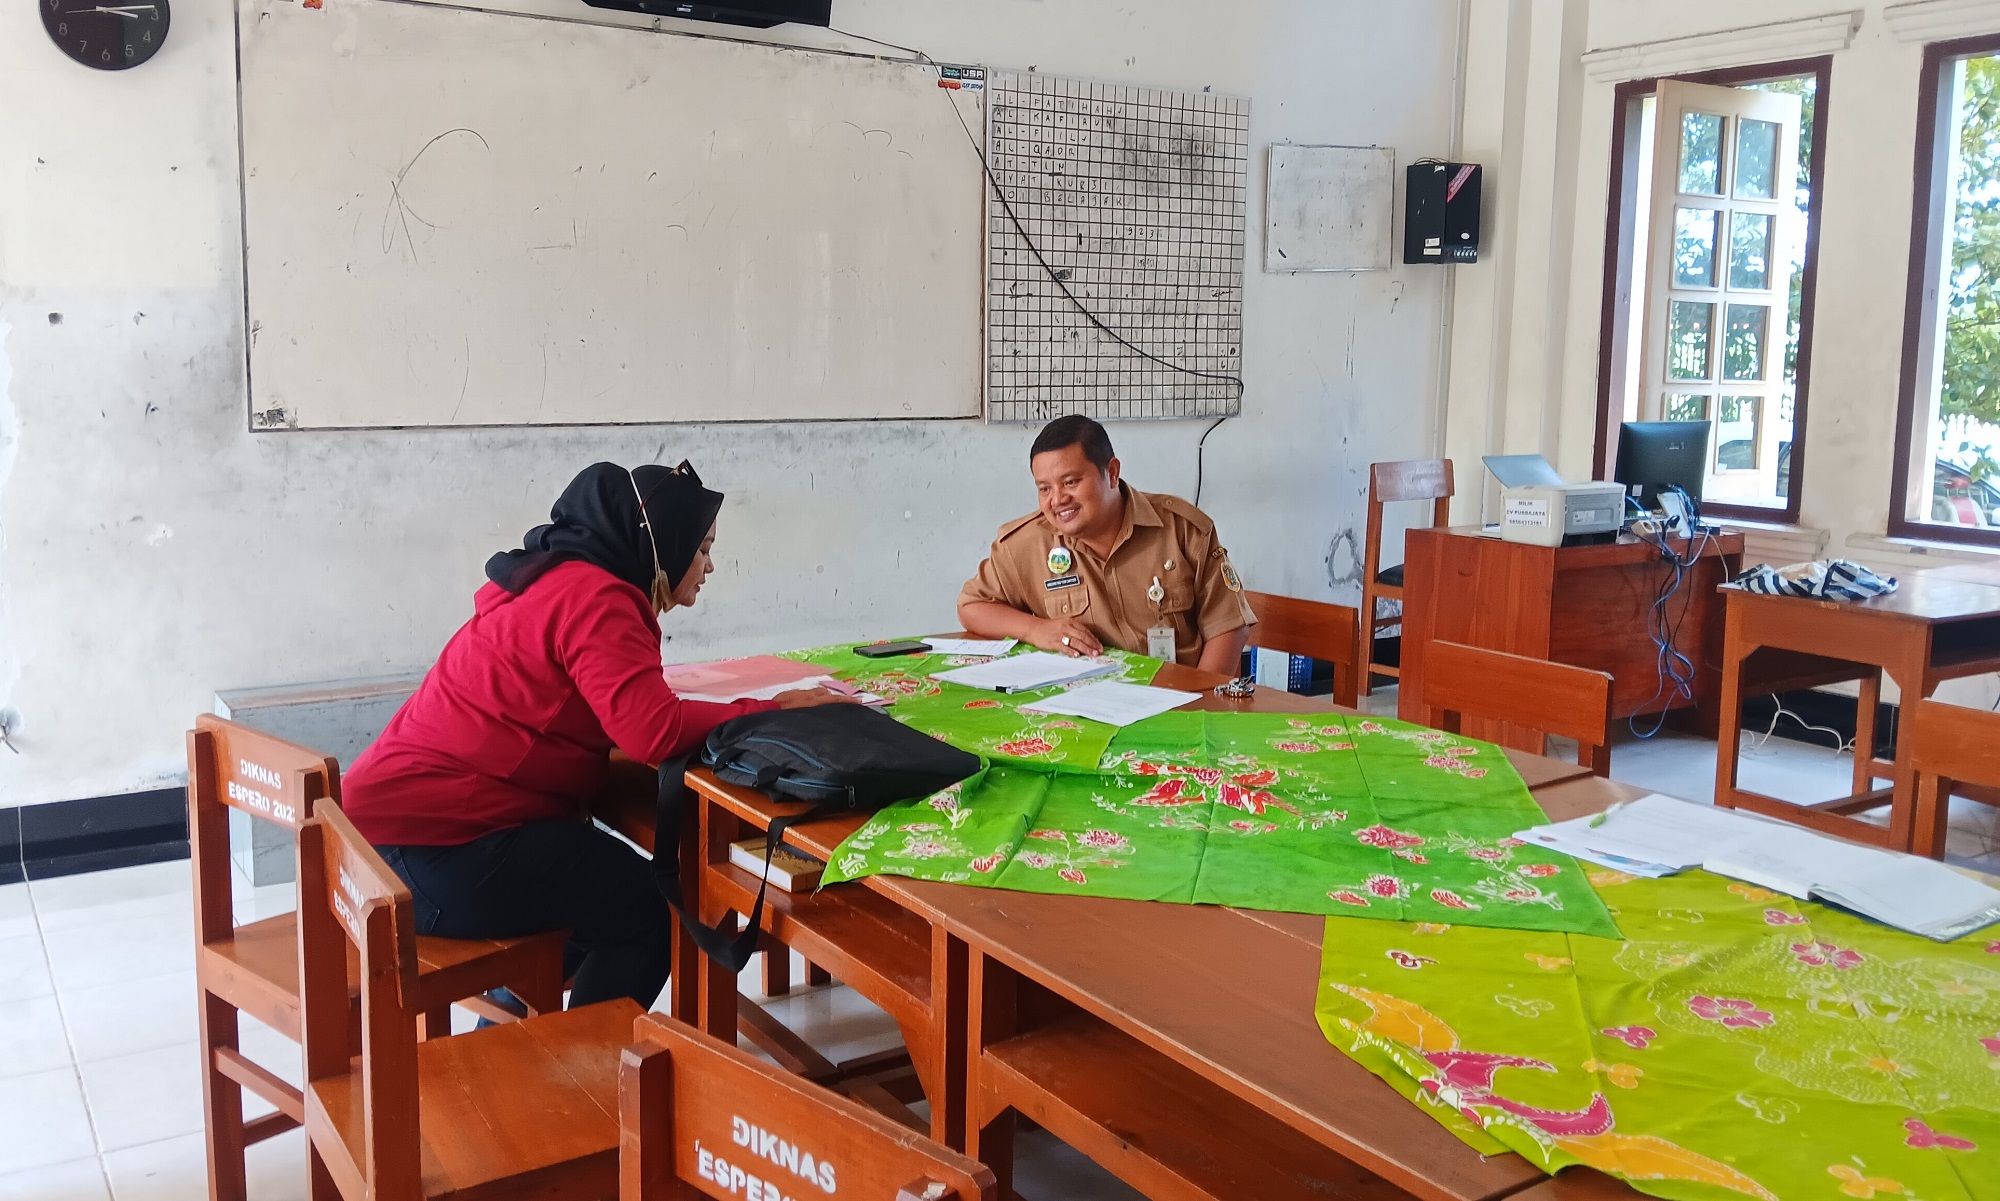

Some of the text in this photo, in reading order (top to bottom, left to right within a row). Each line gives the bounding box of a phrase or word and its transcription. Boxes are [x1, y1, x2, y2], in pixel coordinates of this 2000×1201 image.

[50, 0, 59, 11] 9
[150, 8, 159, 20] 3
[59, 23, 68, 36] 8
[143, 30, 151, 43] 4
[80, 40, 87, 53] 7
[125, 44, 134, 57] 5
[101, 48, 110, 61] 6
[962, 69, 983, 79] USA
[240, 758, 282, 790] DIKNAS
[228, 780, 270, 811] ESPERO
[732, 1114, 837, 1195] DIKNAS
